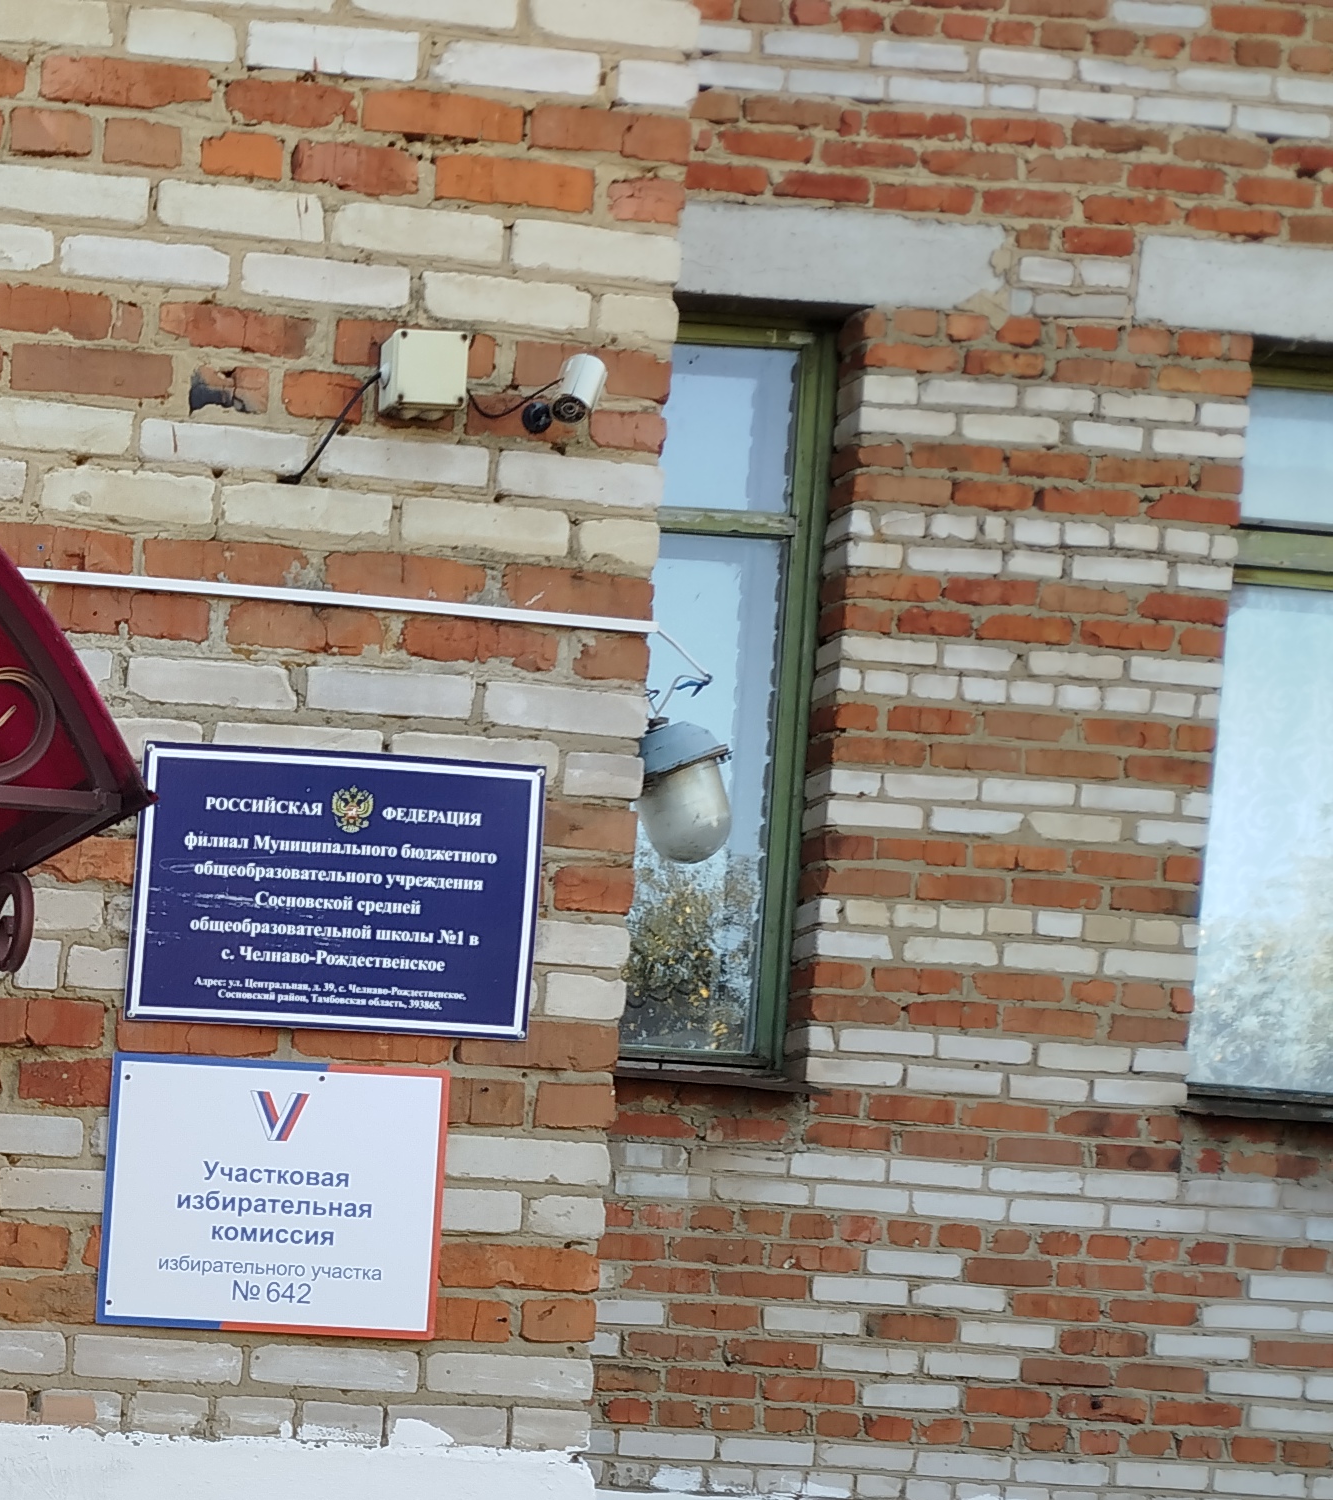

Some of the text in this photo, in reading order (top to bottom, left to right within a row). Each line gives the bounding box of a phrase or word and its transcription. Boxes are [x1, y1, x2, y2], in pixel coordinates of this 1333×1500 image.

[205, 796, 482, 827] РОССИЙСКАЯ ФЕДЕРАЦИЯ
[184, 831, 497, 864] филиал Муниципального бюджетного
[194, 860, 483, 891] общеобразовательного учреждения
[255, 890, 421, 915] Сосновской средней
[190, 916, 480, 946] общеобразовательной школы №1 в
[221, 945, 445, 972] с. Челнаво-Рождественское
[193, 976, 227, 989] Адрес:
[228, 980, 243, 989] ул.
[244, 978, 311, 992] Центральная,
[217, 988, 276, 1001] Сосновский
[277, 992, 309, 1003] район,
[310, 993, 366, 1006] Тамбовская
[202, 1160, 350, 1188] Участковая
[176, 1190, 373, 1219] избирательная
[211, 1224, 335, 1246] комиссия
[158, 1255, 382, 1281] избирательного участка
[232, 1280, 312, 1305] № 642
